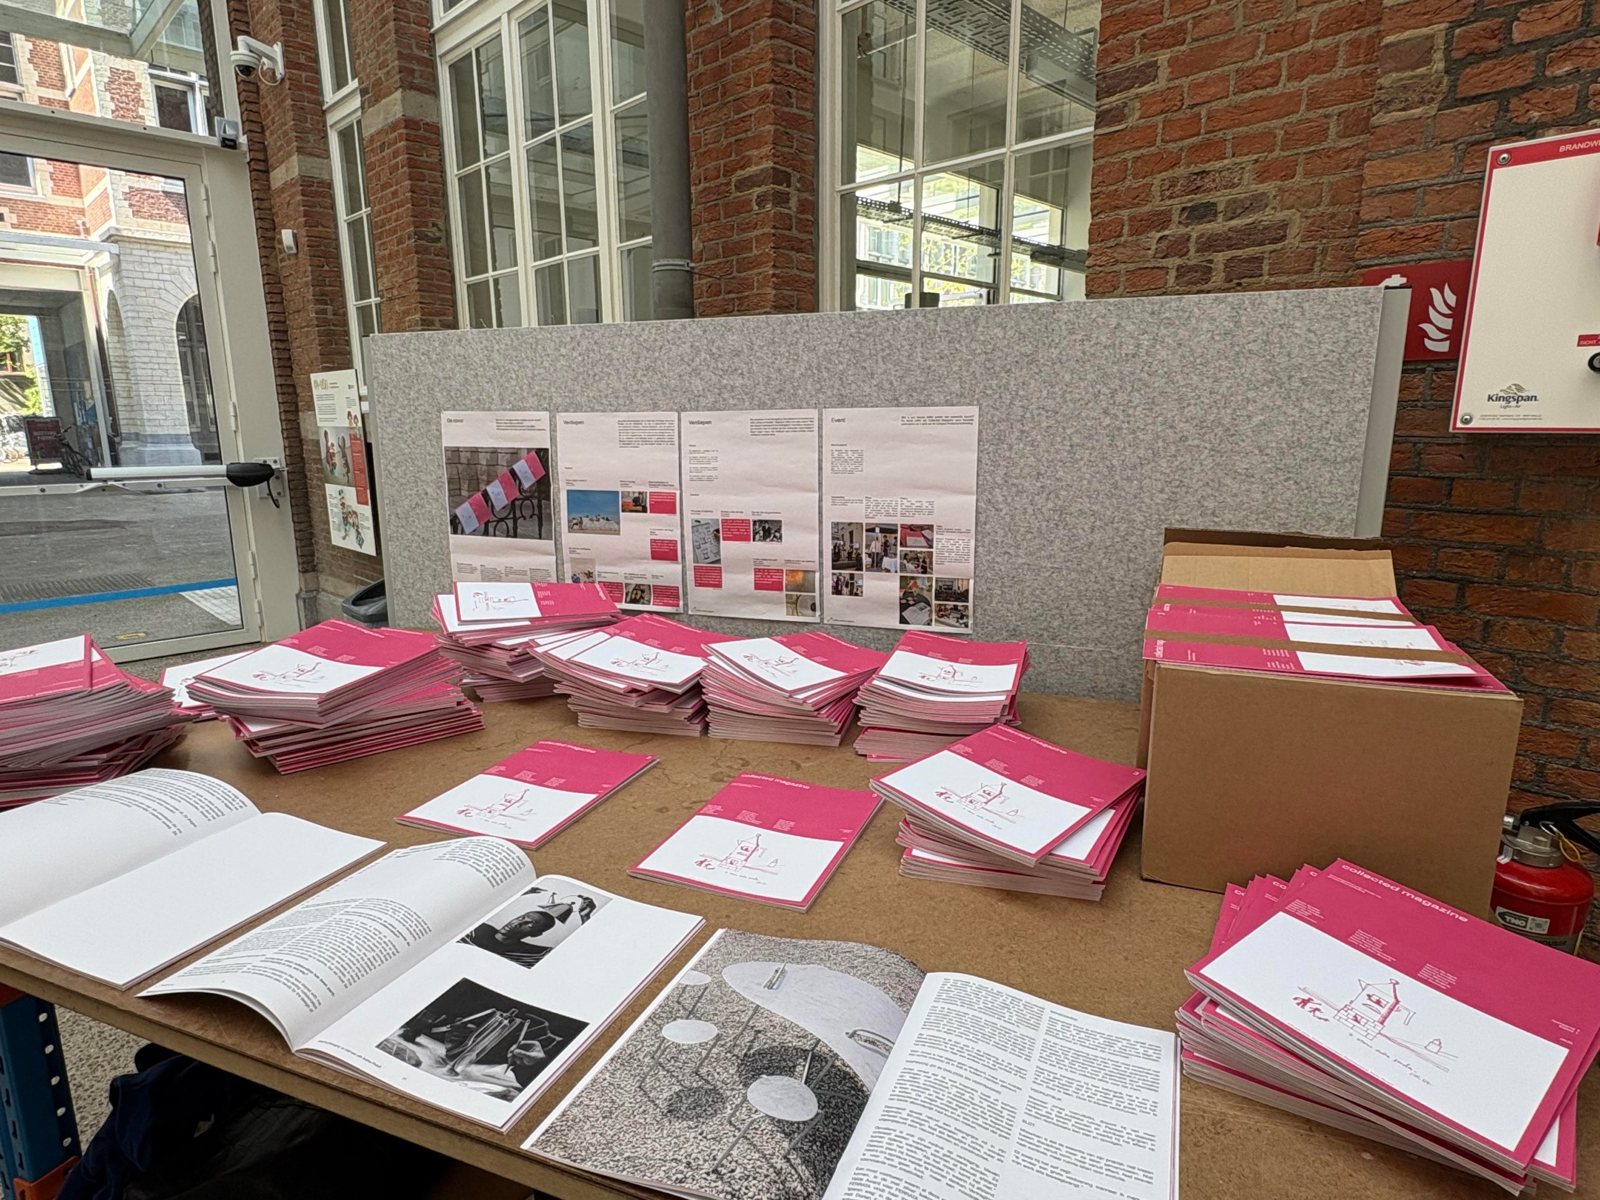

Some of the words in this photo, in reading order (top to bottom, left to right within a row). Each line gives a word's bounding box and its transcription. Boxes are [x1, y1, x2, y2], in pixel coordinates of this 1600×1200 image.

[1487, 393, 1537, 404] Kingspan
[1341, 864, 1401, 892] collected
[1400, 890, 1469, 923] magazine
